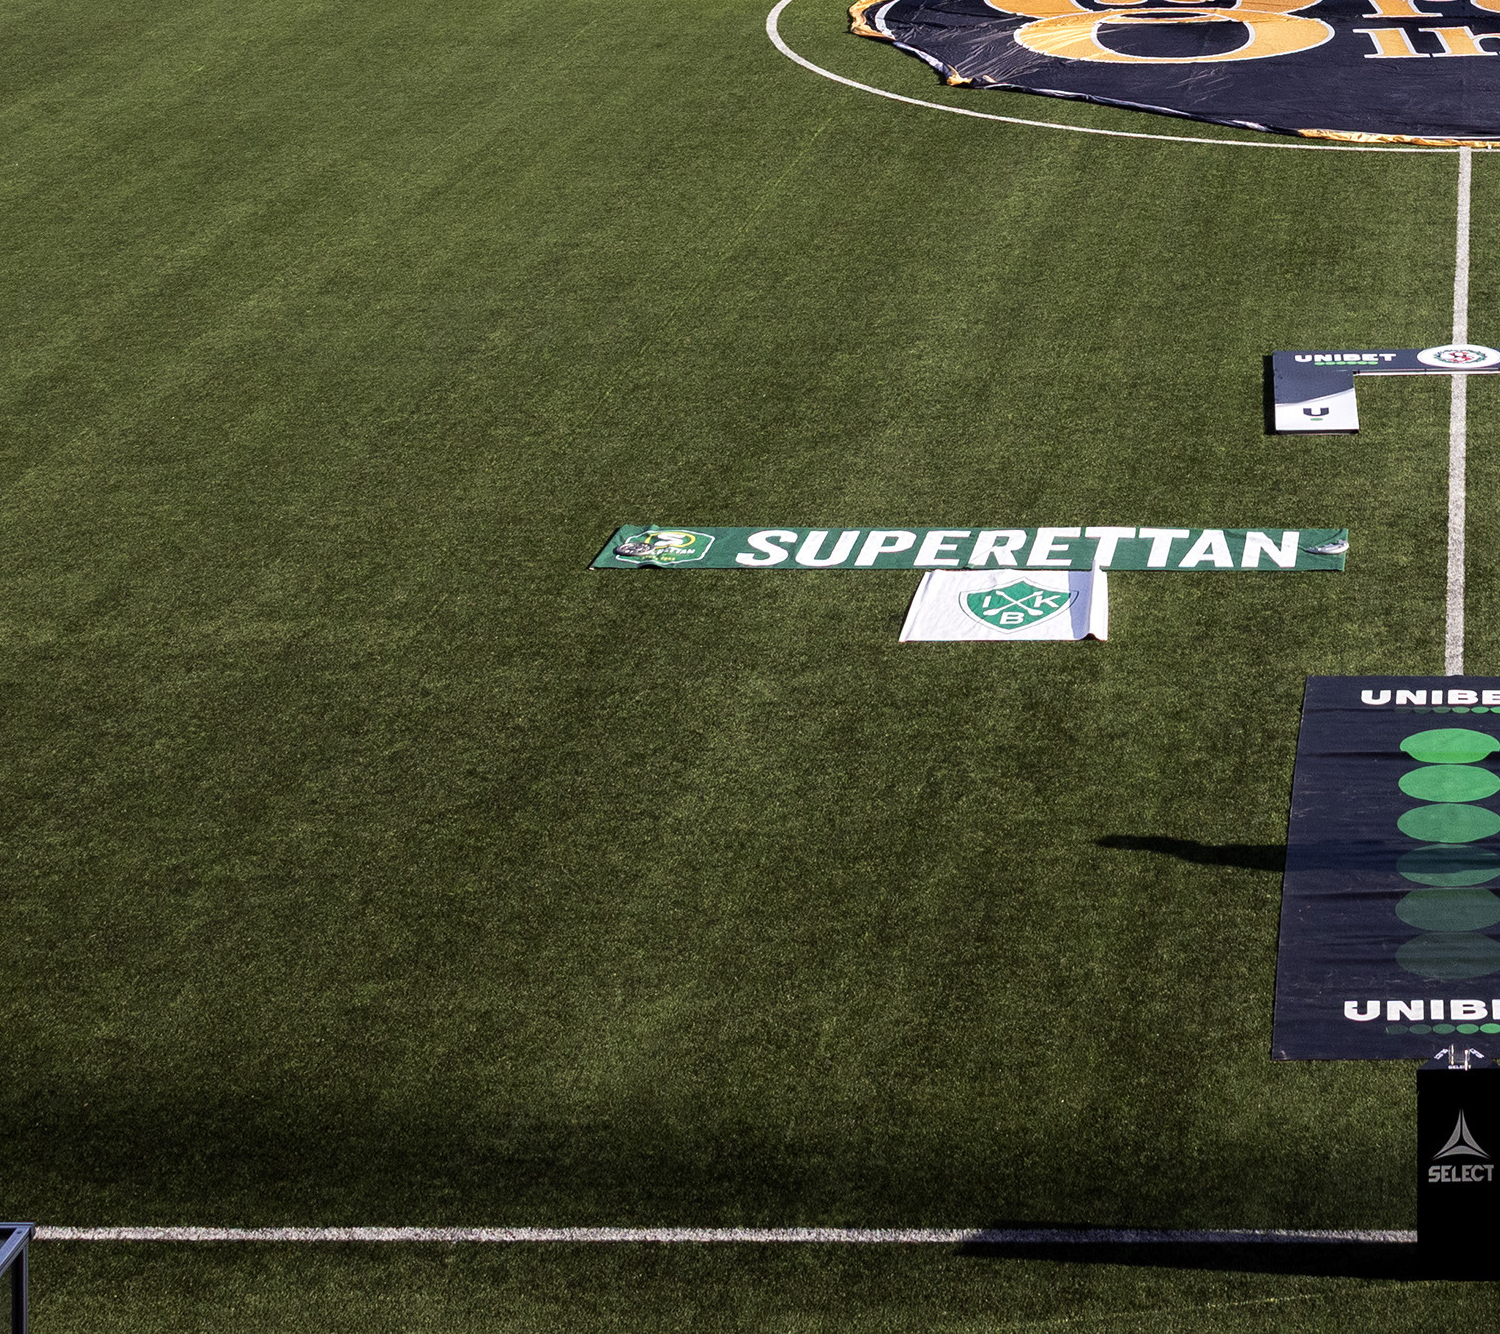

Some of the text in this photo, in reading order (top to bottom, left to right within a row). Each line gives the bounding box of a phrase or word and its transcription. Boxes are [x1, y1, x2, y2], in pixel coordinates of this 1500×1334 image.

[1294, 353, 1396, 363] UNIBET
[735, 527, 1300, 568] SUPERETTAN
[1428, 1164, 1494, 1183] SELECT
